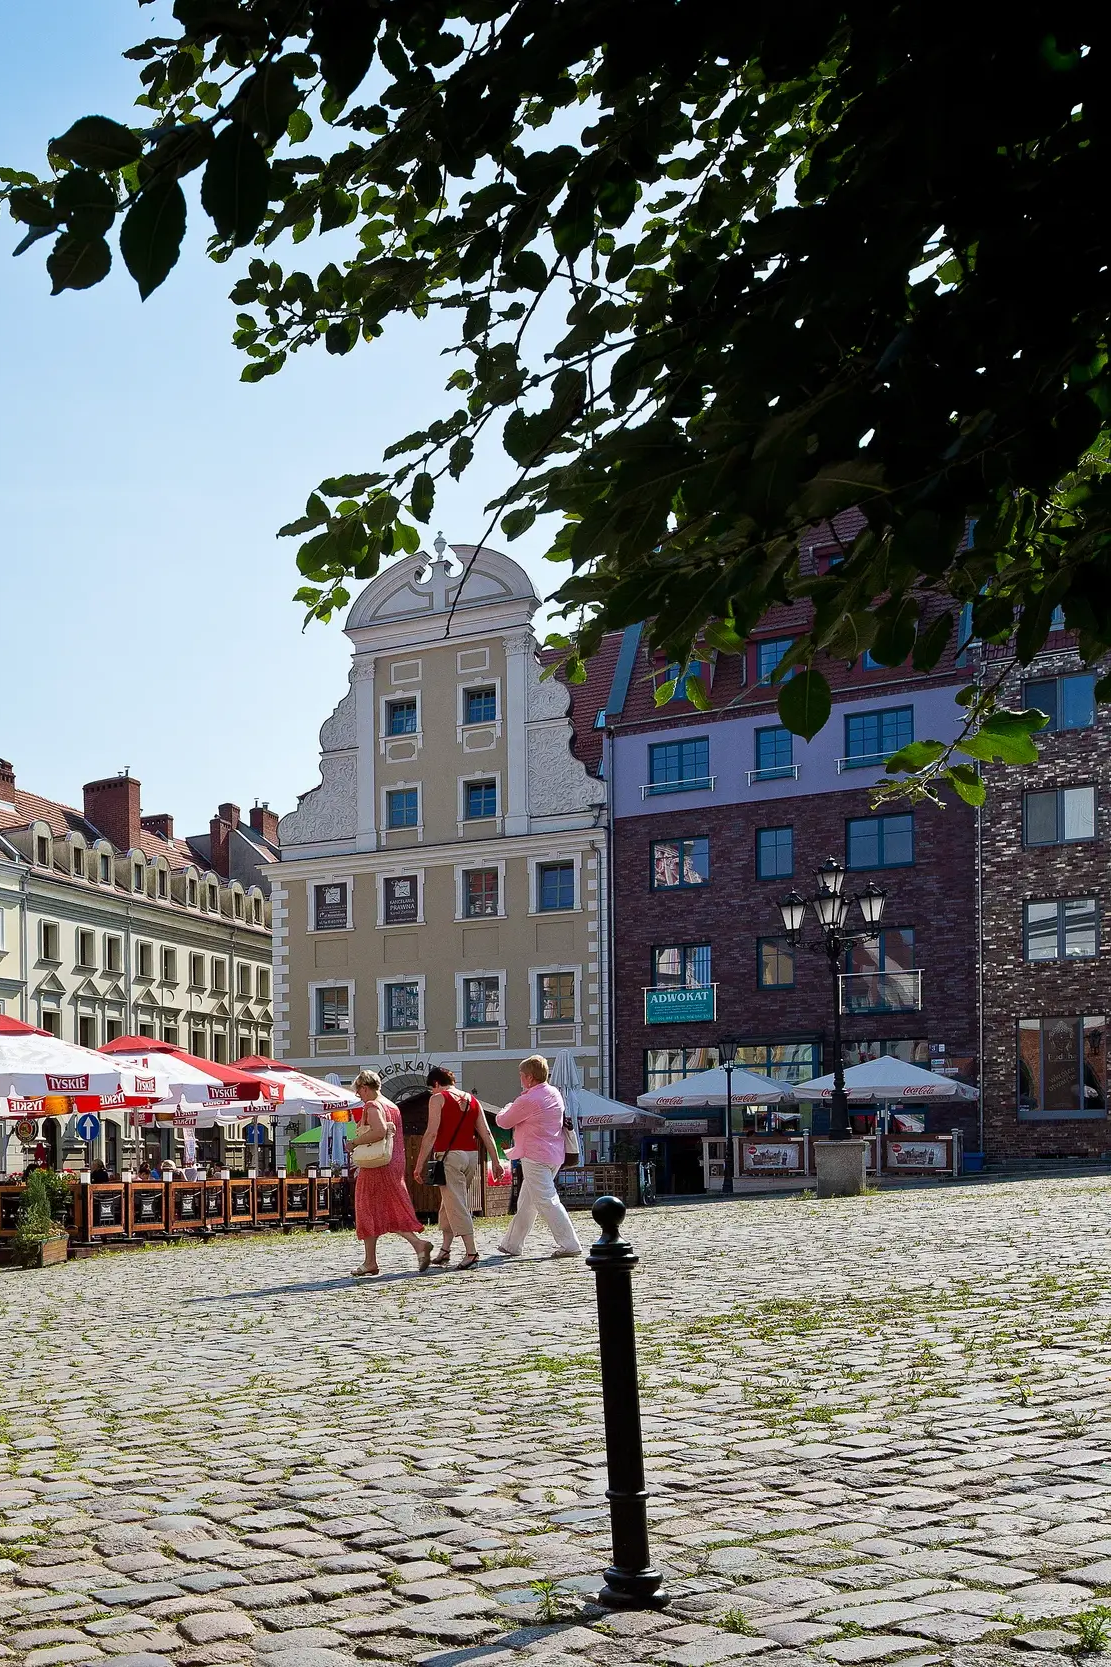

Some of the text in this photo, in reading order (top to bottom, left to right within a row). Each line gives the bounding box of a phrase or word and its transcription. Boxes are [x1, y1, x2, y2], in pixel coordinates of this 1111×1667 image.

[389, 903, 415, 911] PRAWNA
[650, 991, 709, 1003] ADWOKAT
[49, 1076, 87, 1090] TYSKIE
[136, 1078, 155, 1092] TYSKIE
[209, 1087, 238, 1098] TYSKIE
